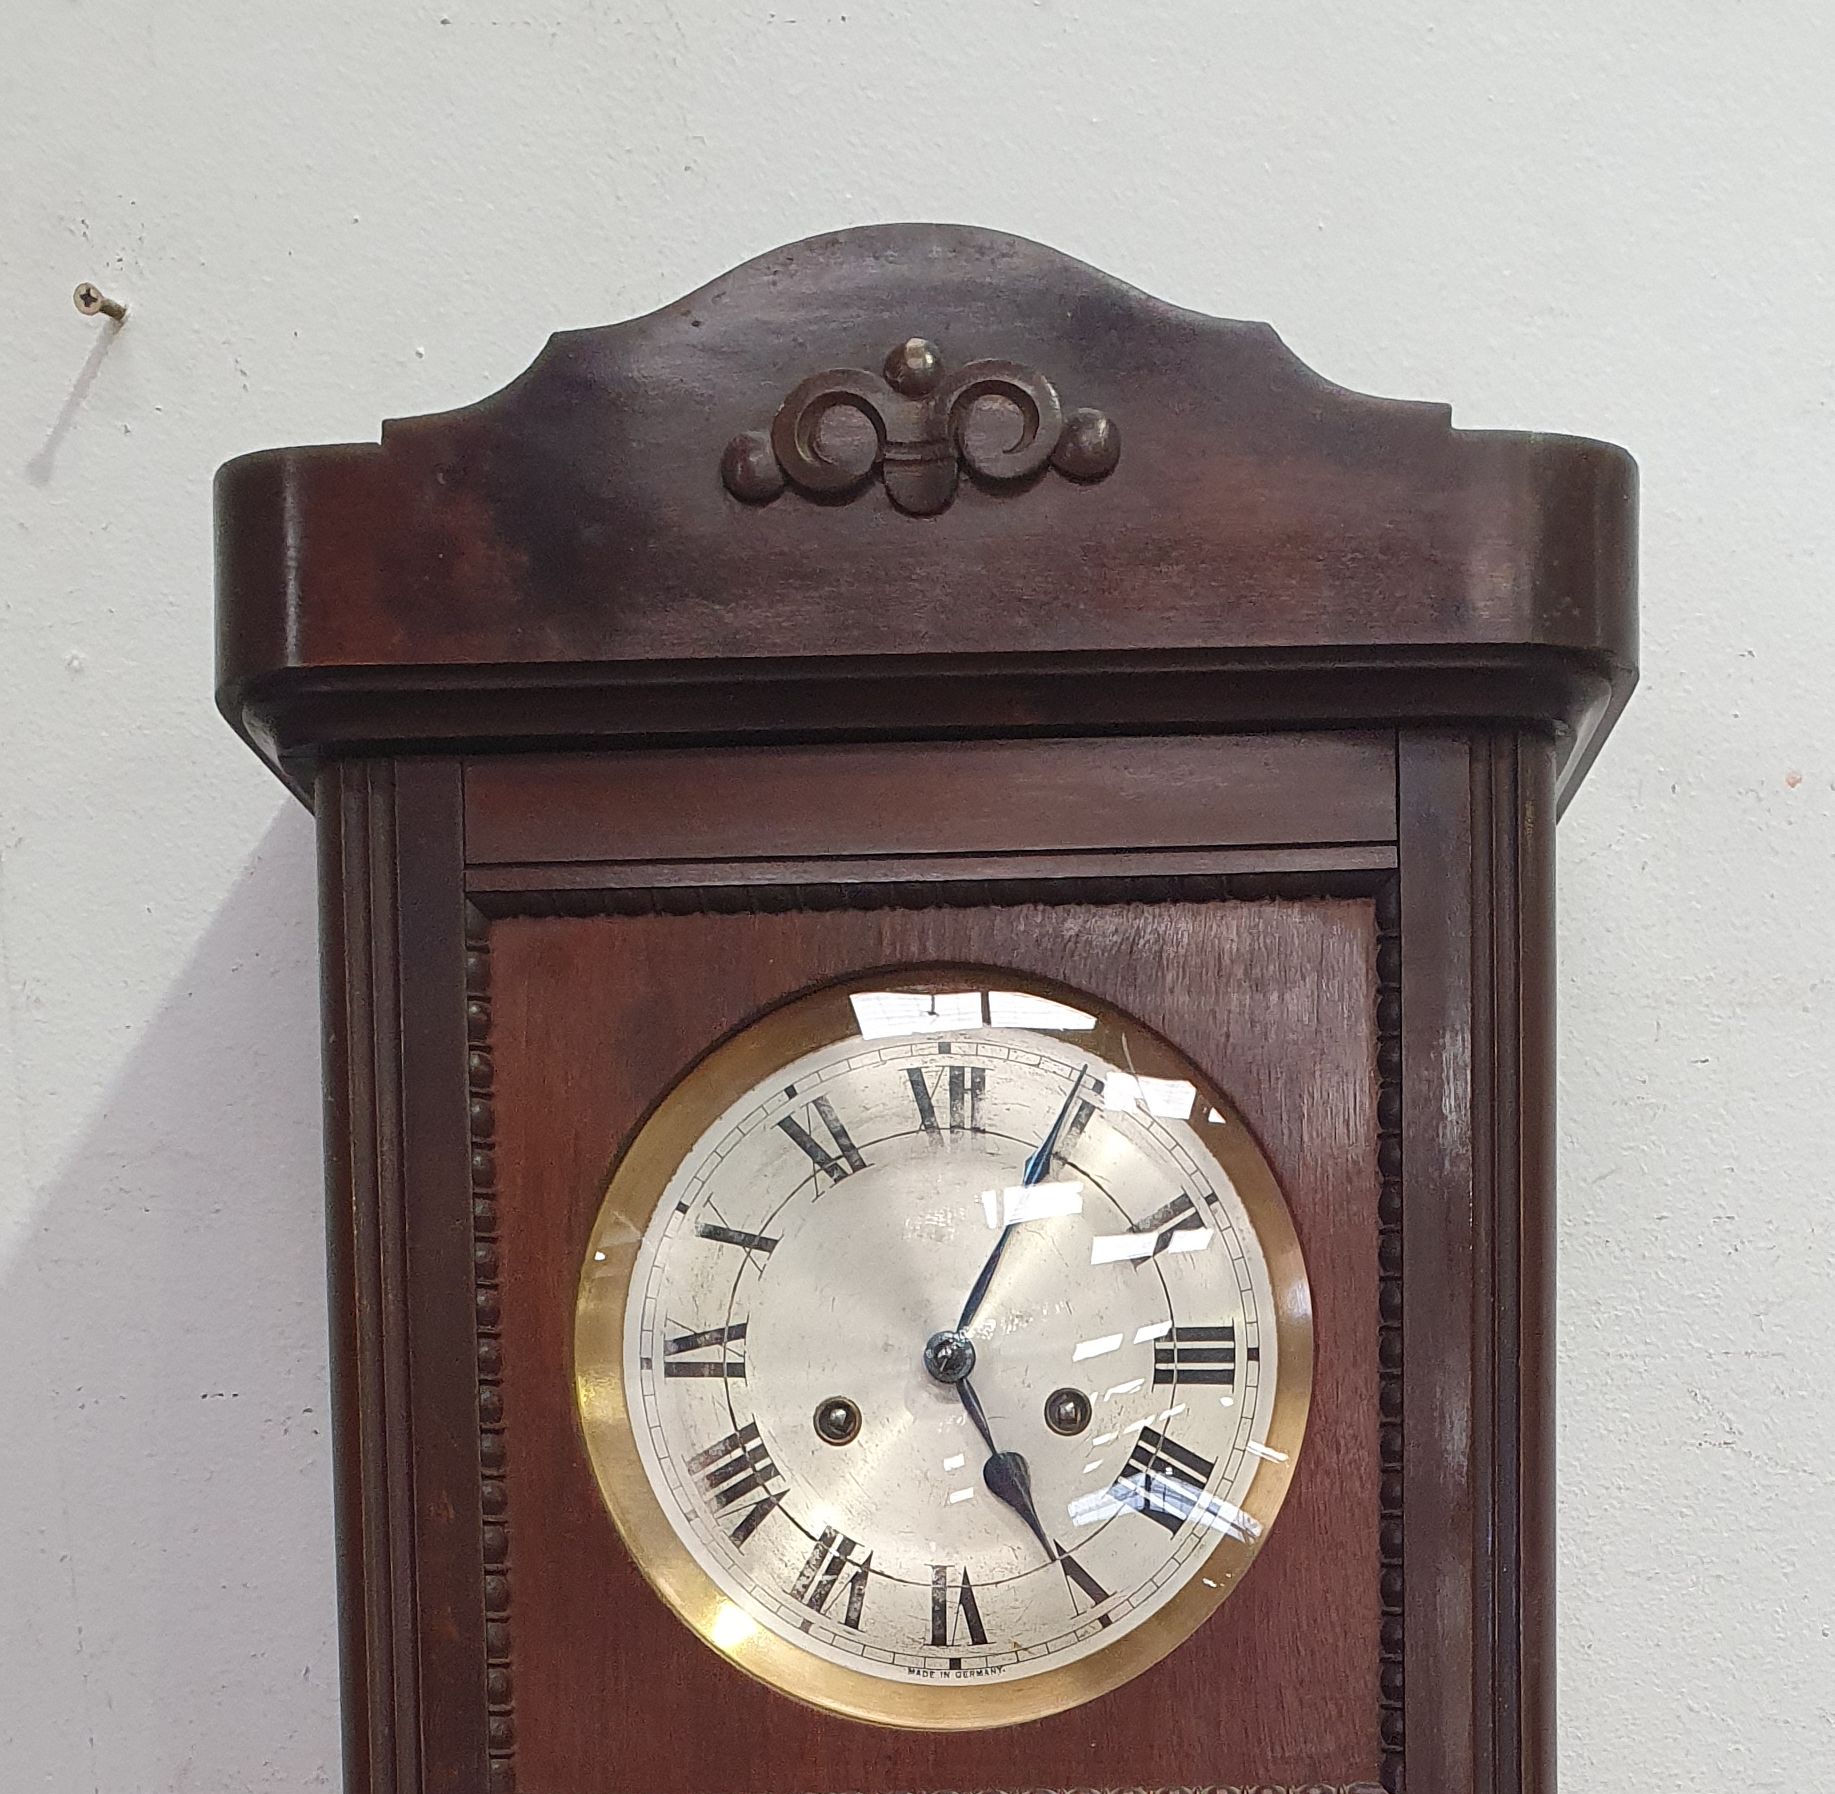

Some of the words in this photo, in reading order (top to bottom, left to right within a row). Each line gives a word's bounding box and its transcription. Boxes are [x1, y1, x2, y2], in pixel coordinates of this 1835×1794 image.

[899, 1065, 995, 1146] XII
[771, 1094, 875, 1202] XI
[694, 1192, 784, 1281] X
[1127, 1186, 1207, 1274] II
[664, 1309, 749, 1387] IX
[1151, 1317, 1235, 1394] III
[680, 1413, 790, 1556] VIII
[782, 1525, 873, 1633] VII
[923, 1563, 996, 1647] VI
[1053, 1538, 1118, 1619] V
[907, 1667, 935, 1679] MADE
[940, 1671, 950, 1679] IN
